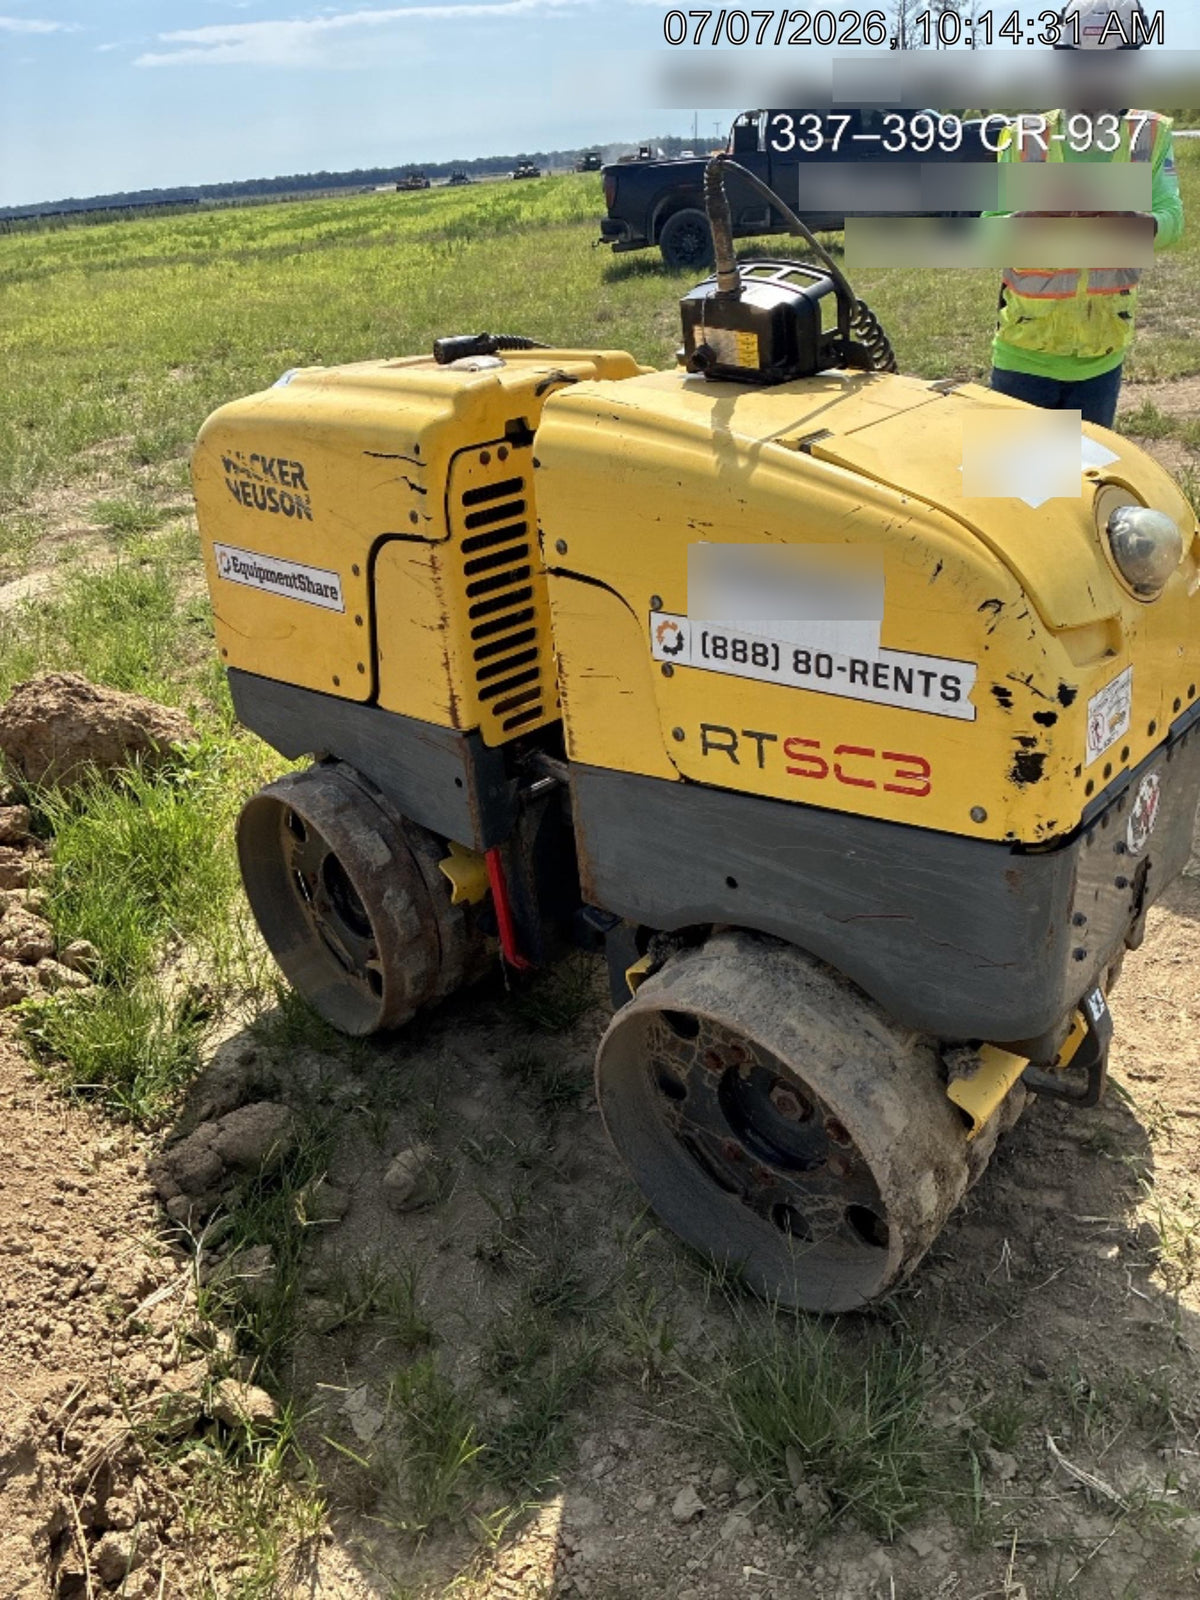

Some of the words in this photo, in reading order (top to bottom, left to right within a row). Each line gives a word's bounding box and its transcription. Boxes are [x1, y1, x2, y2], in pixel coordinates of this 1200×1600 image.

[231, 556, 339, 600] EquipmentShare
[701, 630, 780, 671] (888)
[792, 650, 962, 703] 80-RENTS
[699, 723, 932, 798] RTSC3
